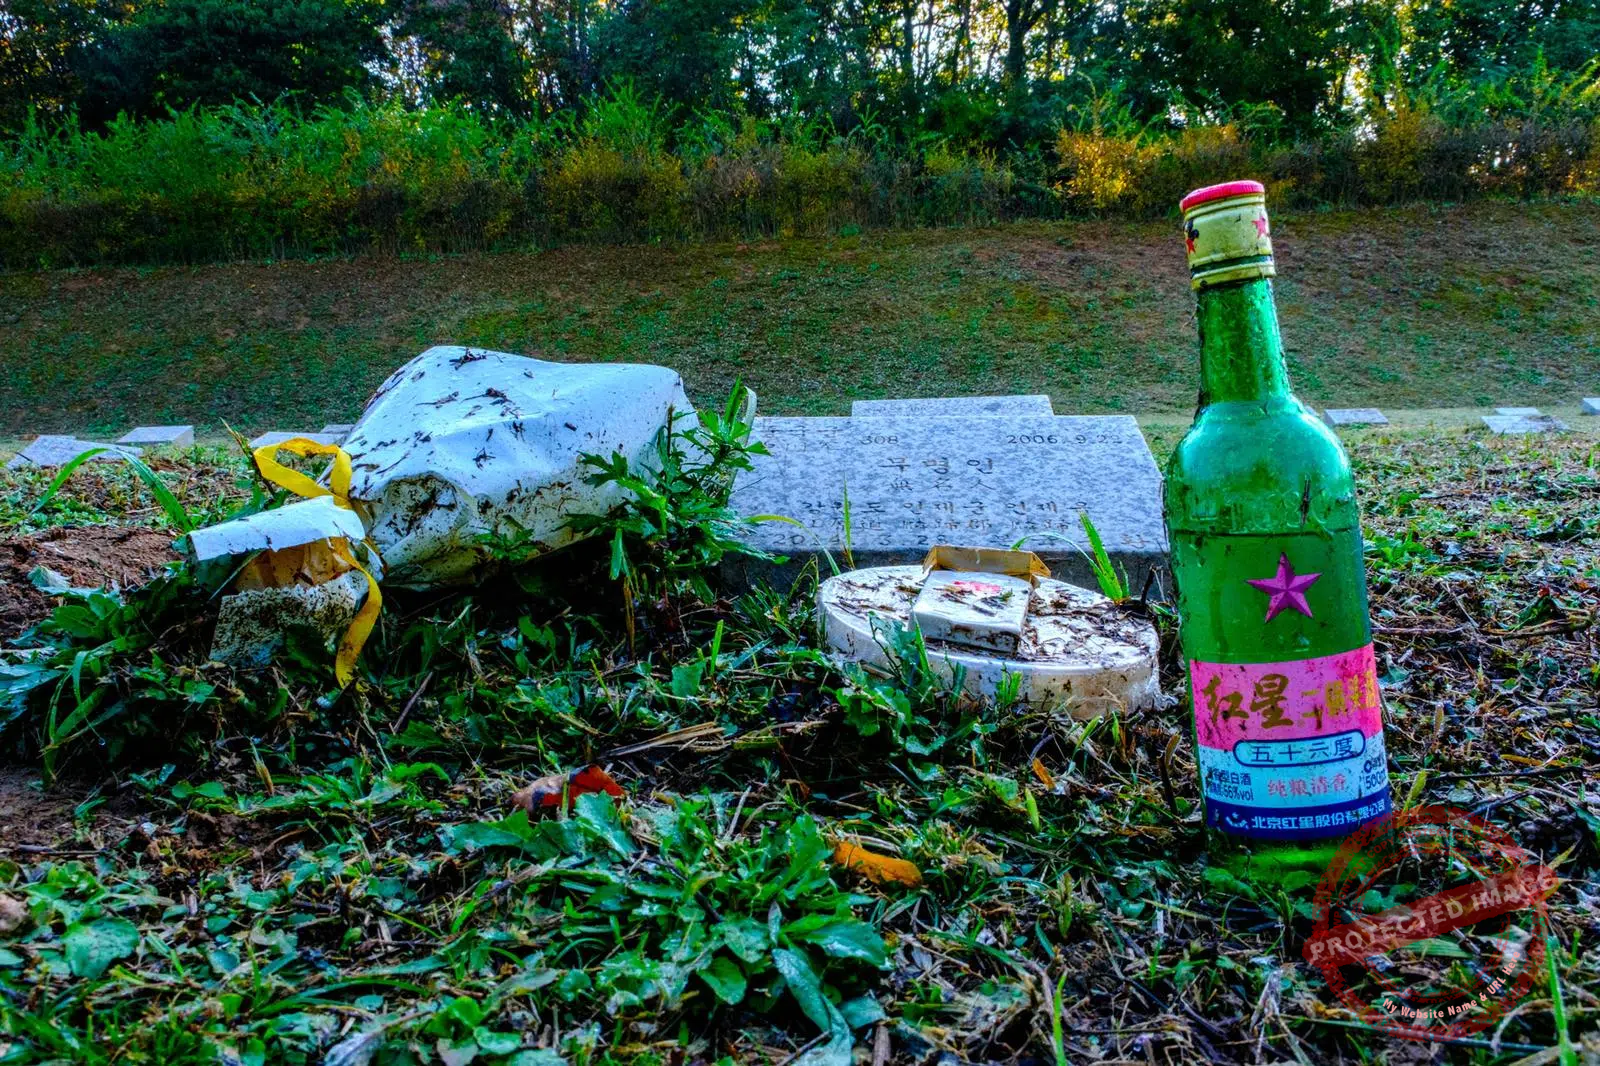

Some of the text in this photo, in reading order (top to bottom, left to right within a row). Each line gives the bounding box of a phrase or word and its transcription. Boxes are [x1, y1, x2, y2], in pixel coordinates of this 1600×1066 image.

[877, 456, 993, 475] 무명인
[903, 500, 988, 515] 인제군
[1201, 673, 1295, 730] 红星
[1251, 735, 1357, 764] 五十六度
[1251, 799, 1386, 830] 北京红星股份有限公司
